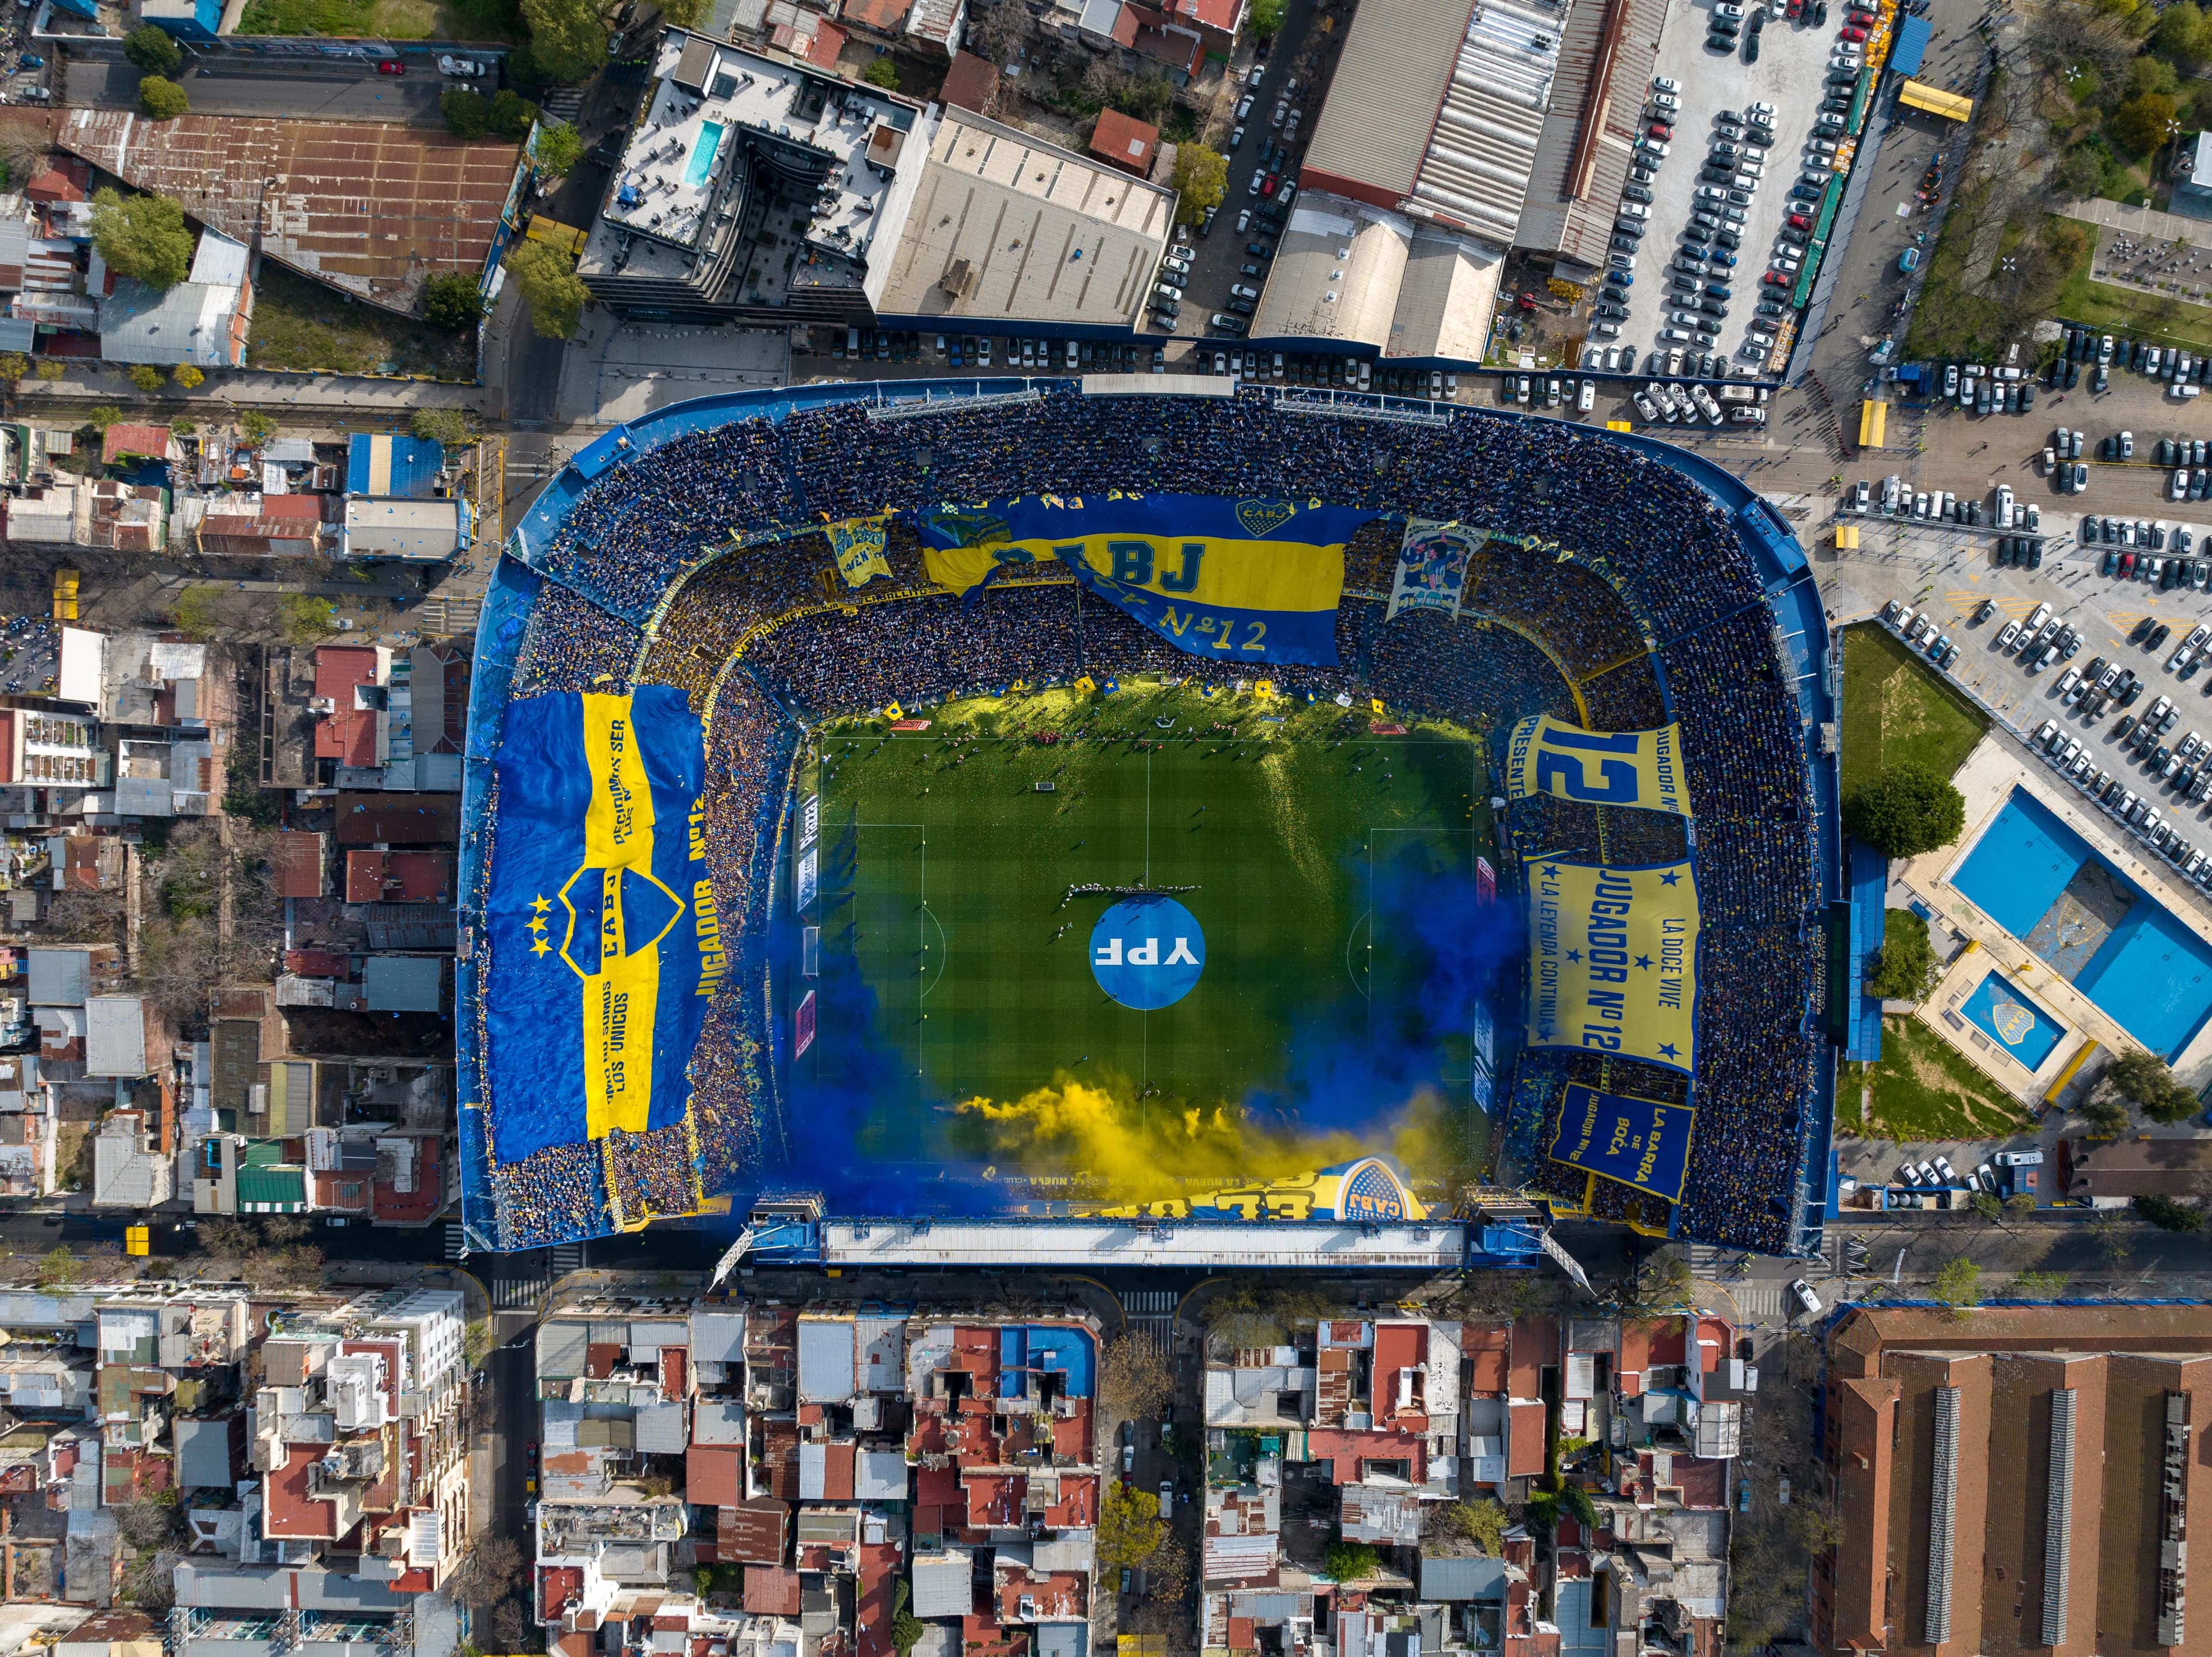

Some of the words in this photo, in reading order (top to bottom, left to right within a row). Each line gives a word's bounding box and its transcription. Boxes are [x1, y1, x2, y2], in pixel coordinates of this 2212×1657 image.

[1244, 510, 1286, 519] CABJ
[790, 525, 819, 536] BARRIO
[1435, 563, 1445, 582] 10
[664, 574, 688, 603] BERNAL
[706, 686, 721, 713] BOSTERO
[610, 720, 625, 752] SER
[1510, 717, 1540, 800] PRESENTE
[1536, 727, 1639, 804] 12
[1656, 728, 1676, 793] JUGADOR
[800, 801, 818, 850] Piazza
[1540, 882, 1560, 896] LA
[604, 873, 619, 958] CABJ
[1540, 901, 1559, 960] LEYENDA
[1587, 870, 1633, 983] JUGADOR
[1662, 918, 1685, 934] LA
[693, 877, 728, 1004] JUGADOR
[1095, 937, 1200, 966] YPF
[1661, 939, 1683, 974] DOCE
[603, 980, 612, 1033] SOMOS
[1539, 961, 1558, 1026] CONTINUA
[1658, 979, 1682, 1009] VIVE
[610, 992, 629, 1053] UNICOS
[2003, 1010, 2025, 1036] CABJ
[603, 1036, 608, 1063] NO
[611, 1060, 625, 1093] LOS
[1581, 1093, 1600, 1137] JUGADOR
[1652, 1107, 1666, 1128] LA
[1605, 1117, 1631, 1156] BOCA
[1631, 1134, 1642, 1150] DE
[603, 1143, 613, 1173] BOCA
[1634, 1131, 1661, 1183] BARRA
[1029, 1177, 1067, 1185] NUEVA
[1071, 1177, 1085, 1185] LA
[1184, 1178, 1223, 1186] NUEVA
[1226, 1178, 1240, 1186] LA
[611, 1199, 622, 1232] ITUZAINGO
[992, 1205, 1029, 1213] DIRECTV
[1349, 1193, 1400, 1216] CABJ
